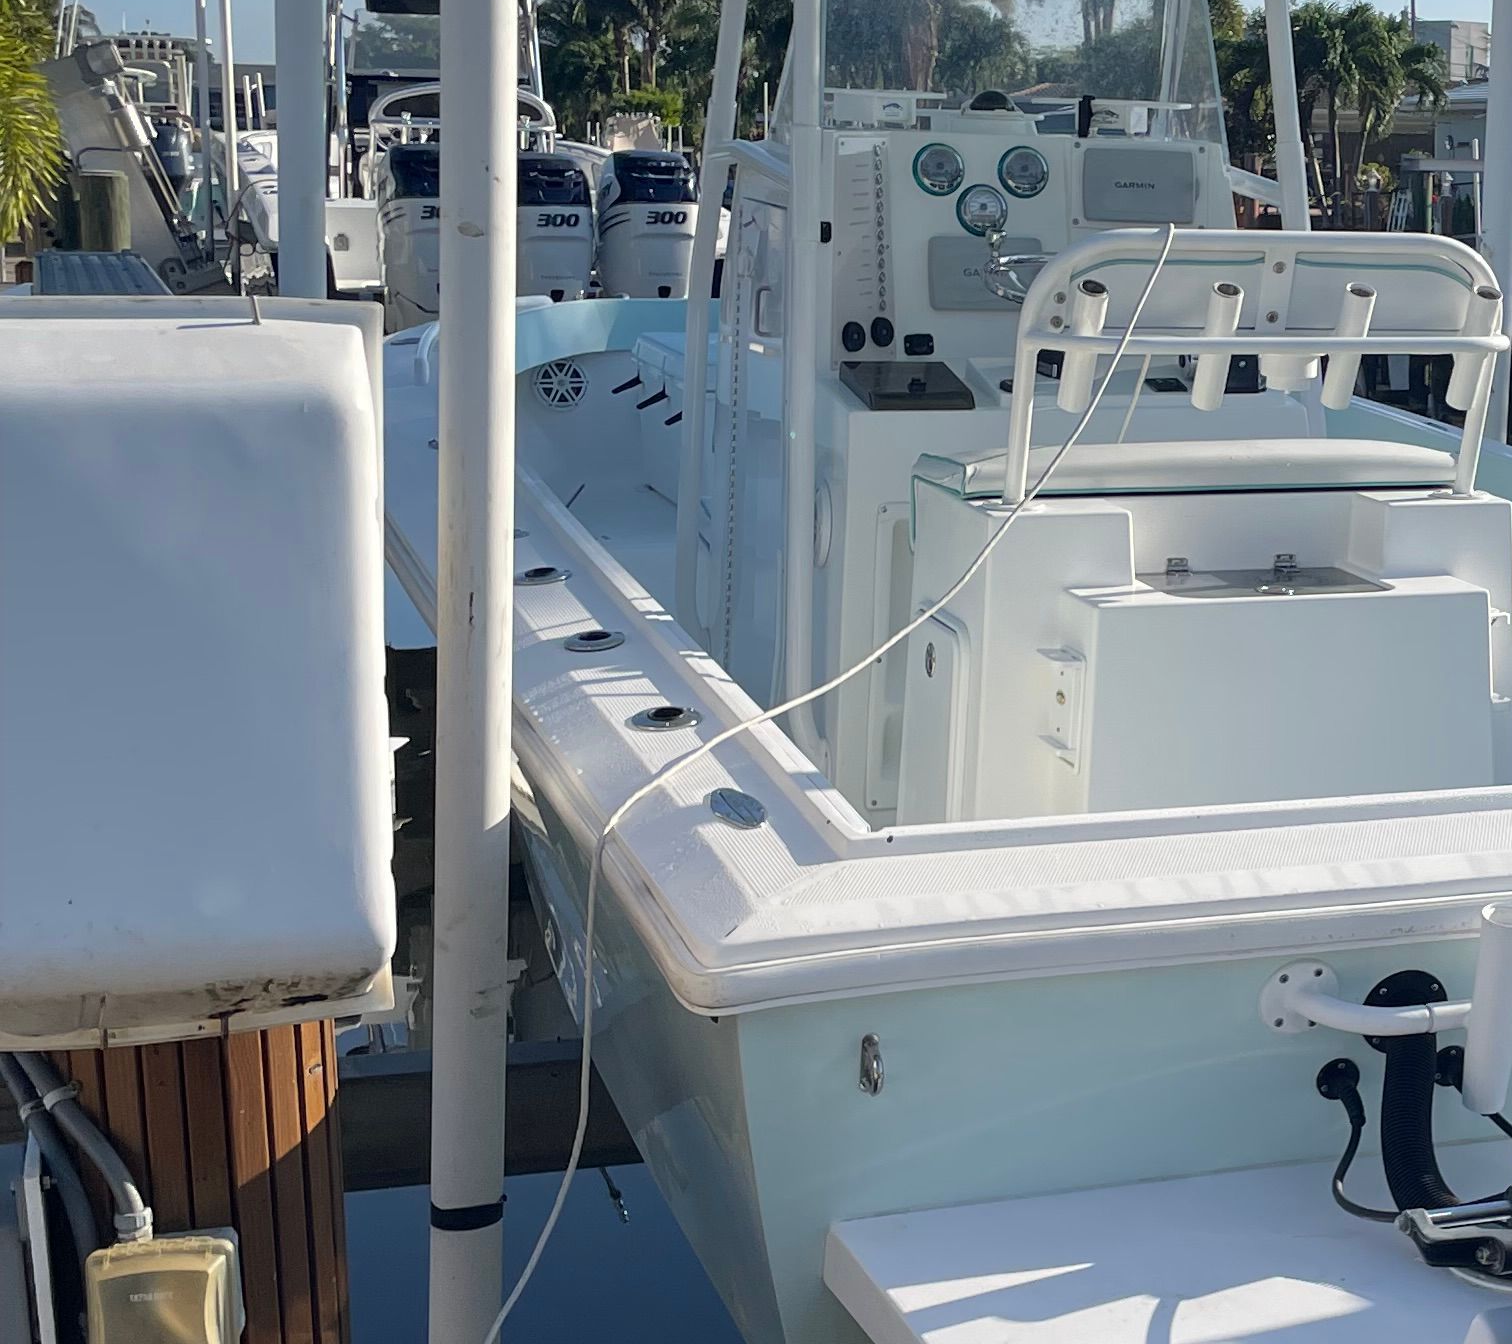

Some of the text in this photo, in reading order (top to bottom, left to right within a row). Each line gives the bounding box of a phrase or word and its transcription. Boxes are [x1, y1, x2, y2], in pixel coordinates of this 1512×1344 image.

[1114, 180, 1155, 190] GARMIN
[536, 213, 580, 227] 300
[645, 210, 688, 225] 300
